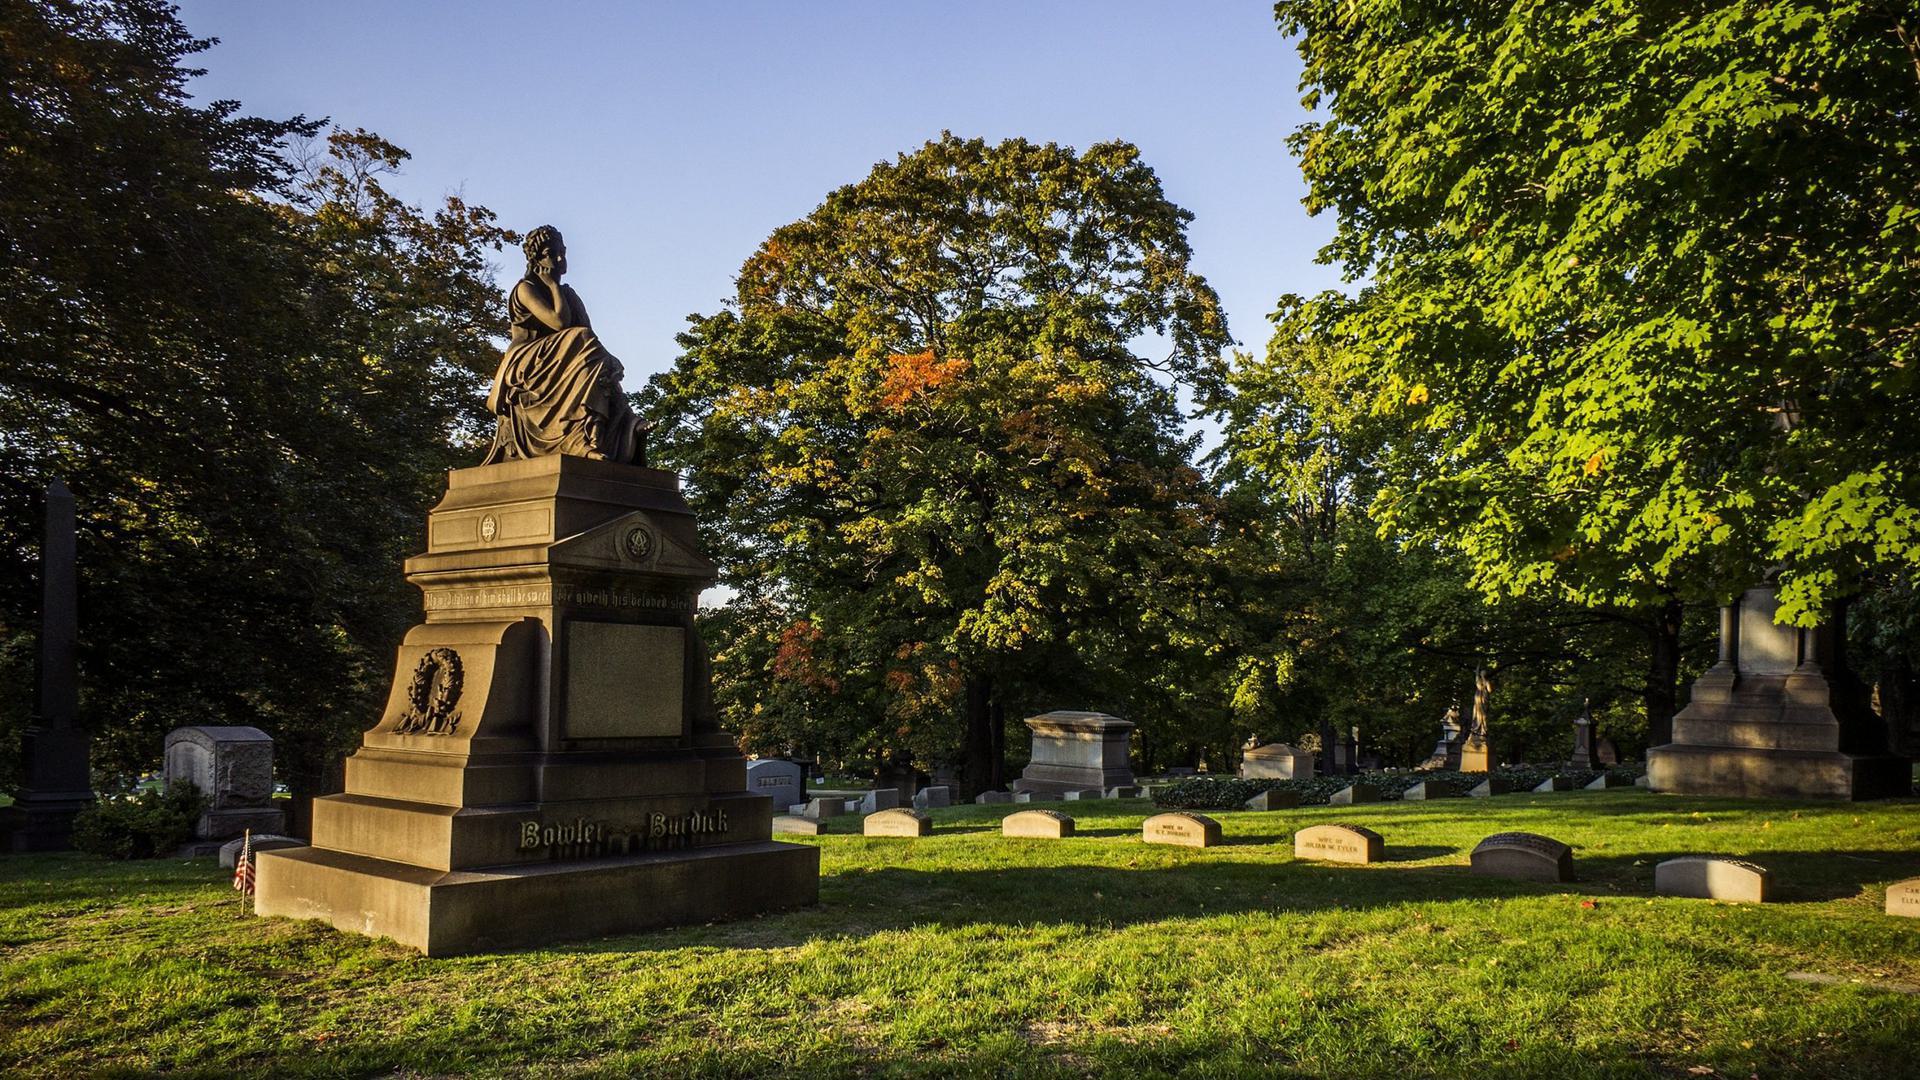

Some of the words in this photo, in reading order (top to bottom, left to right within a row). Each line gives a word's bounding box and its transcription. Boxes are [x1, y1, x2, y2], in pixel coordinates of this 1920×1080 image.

[527, 587, 549, 603] sweet
[576, 589, 608, 608] giveth
[612, 591, 627, 608] his
[630, 591, 668, 609] beloved
[519, 816, 604, 850] Bowler
[647, 807, 728, 839] Burdick
[1304, 841, 1326, 849] JULIAN
